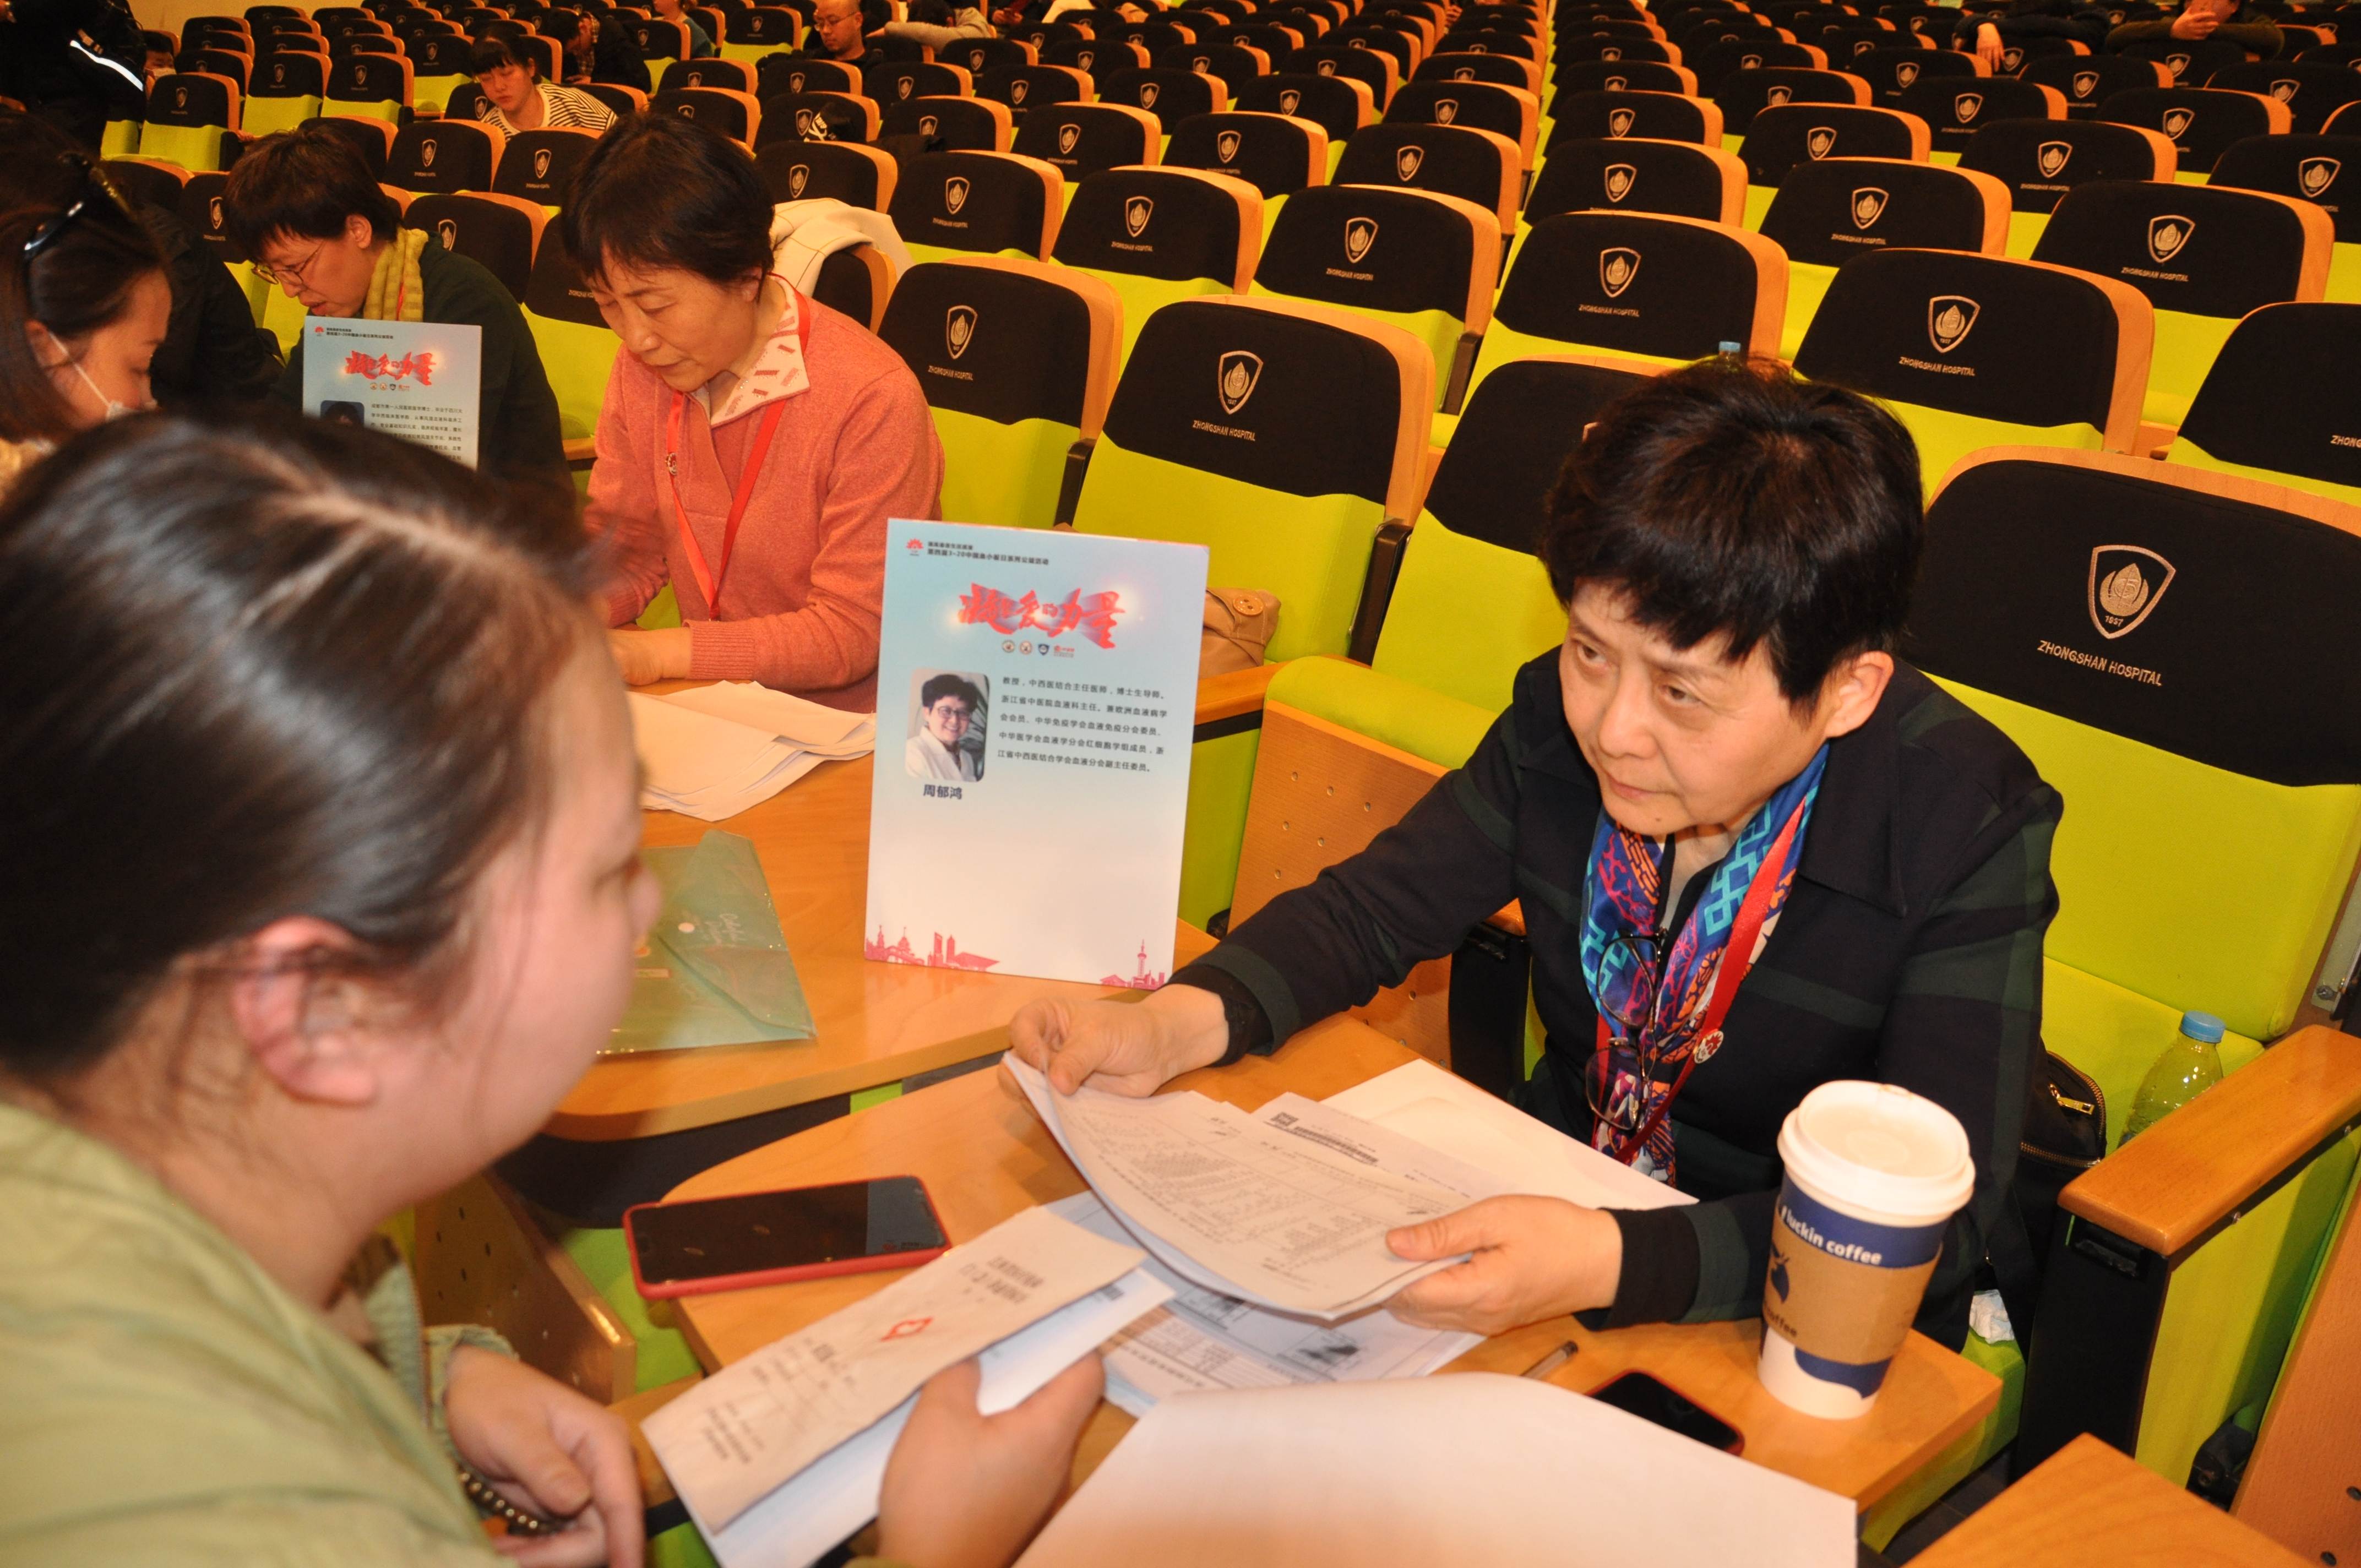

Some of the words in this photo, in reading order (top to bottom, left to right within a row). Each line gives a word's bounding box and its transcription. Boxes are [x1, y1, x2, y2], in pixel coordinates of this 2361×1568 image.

[2121, 266, 2158, 279] ZHONGSHAN
[2159, 272, 2189, 282] HOSPITAL
[1578, 304, 1613, 314] ZHONGSHAN
[928, 365, 953, 378] ZHONGSHAN
[954, 371, 973, 380] HOSPITAL
[1898, 356, 1941, 372] ZHONGSHAN
[1942, 364, 1976, 377] HOSPITAL
[1192, 420, 1227, 435] ZHONGSHAN
[1228, 427, 1255, 442] HOSPITAL
[2105, 615, 2124, 627] 1937
[2037, 640, 2107, 671] ZHONGSHAN
[2108, 660, 2162, 687] HOSPITAL
[923, 784, 962, 799] 周郁鸿
[1787, 1208, 1824, 1248] luckin
[1826, 1240, 1883, 1265] coffee
